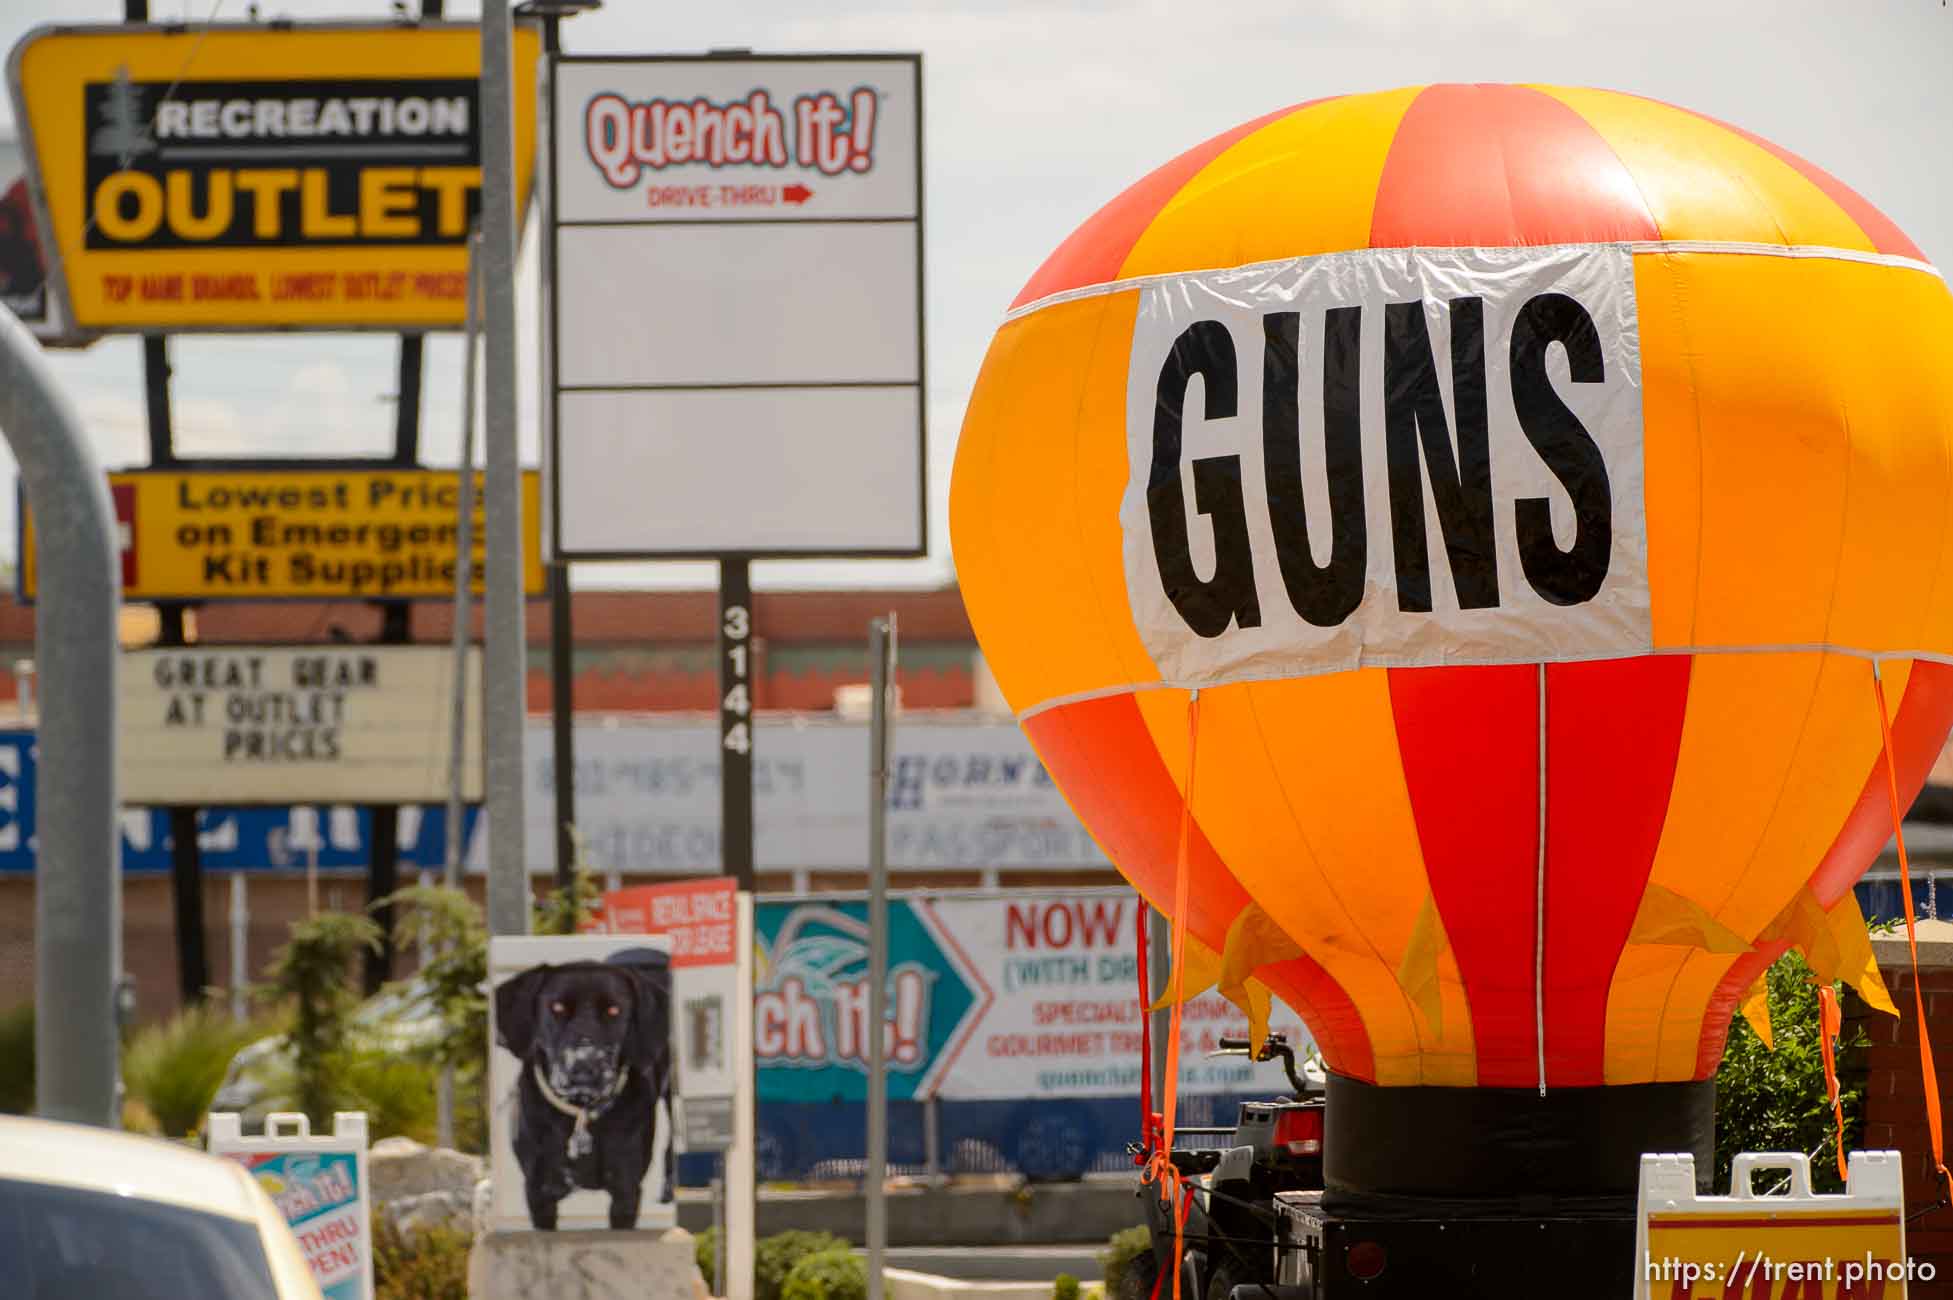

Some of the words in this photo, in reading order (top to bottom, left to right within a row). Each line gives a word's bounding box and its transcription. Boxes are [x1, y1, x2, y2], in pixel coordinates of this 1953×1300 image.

[156, 97, 468, 138] RECREATION
[584, 91, 788, 189] Quench
[94, 166, 484, 241] OUTLET
[1147, 292, 1612, 638] GUNS
[178, 480, 347, 511] Lowest
[176, 520, 232, 549] on
[251, 517, 486, 554] Emergenc
[202, 556, 269, 584] Kit
[153, 655, 264, 689] GREAT
[292, 655, 378, 688] GEAR
[723, 605, 751, 755] 3144
[165, 692, 206, 727] AT
[225, 691, 346, 725] OUTLET
[223, 729, 340, 761] PRICES
[1006, 901, 1123, 951] NOW
[987, 1034, 1103, 1058] GOURMET
